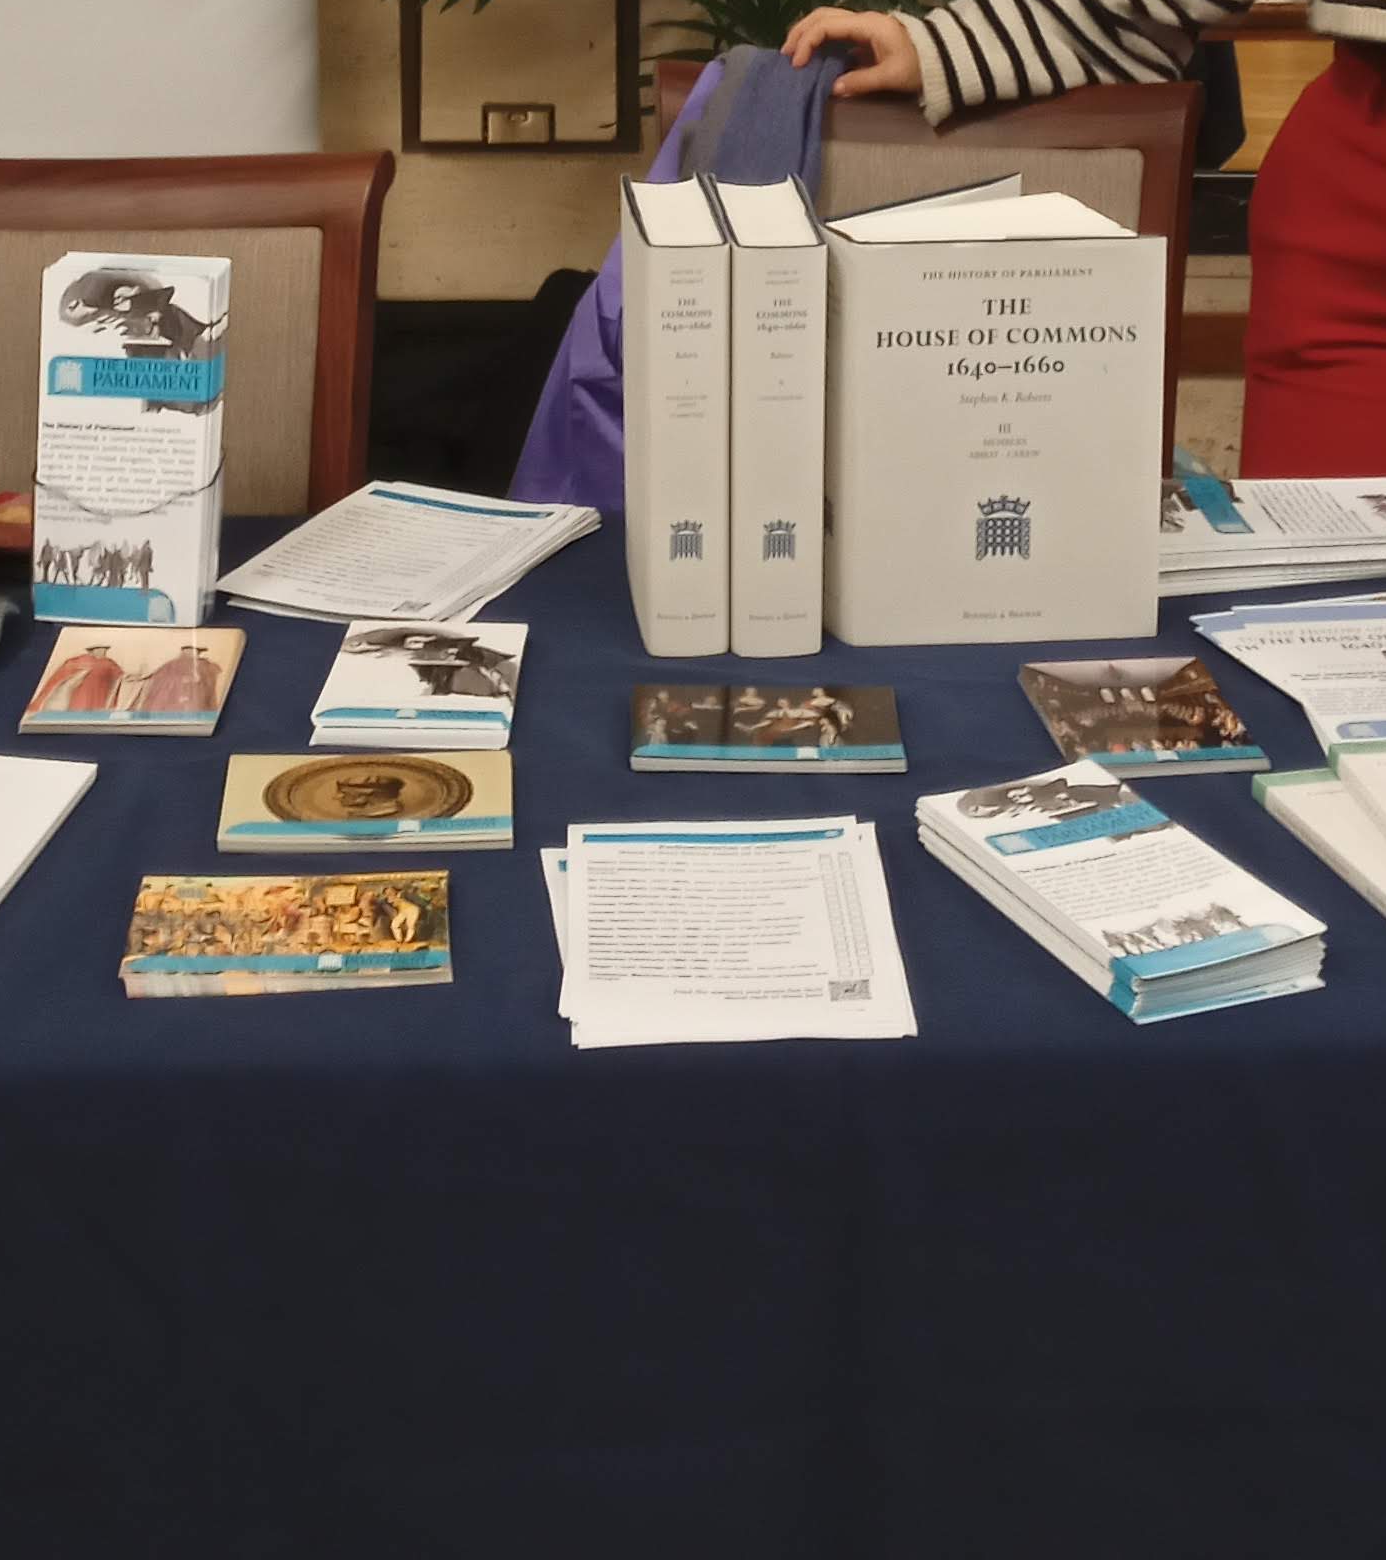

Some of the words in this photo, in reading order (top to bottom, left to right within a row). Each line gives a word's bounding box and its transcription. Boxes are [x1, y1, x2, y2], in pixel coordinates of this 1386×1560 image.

[922, 270, 945, 280] THE
[947, 269, 998, 280] HISTORY
[1001, 269, 1016, 279] OF
[1018, 267, 1094, 279] PARLIAMENT
[981, 297, 1033, 317] THE
[875, 329, 961, 349] HOUSE
[967, 328, 997, 346] OF
[1006, 325, 1139, 345] COMMONS
[124, 359, 180, 373] HISTORY
[184, 361, 201, 374] OF
[92, 371, 203, 392] PARLIAMENT
